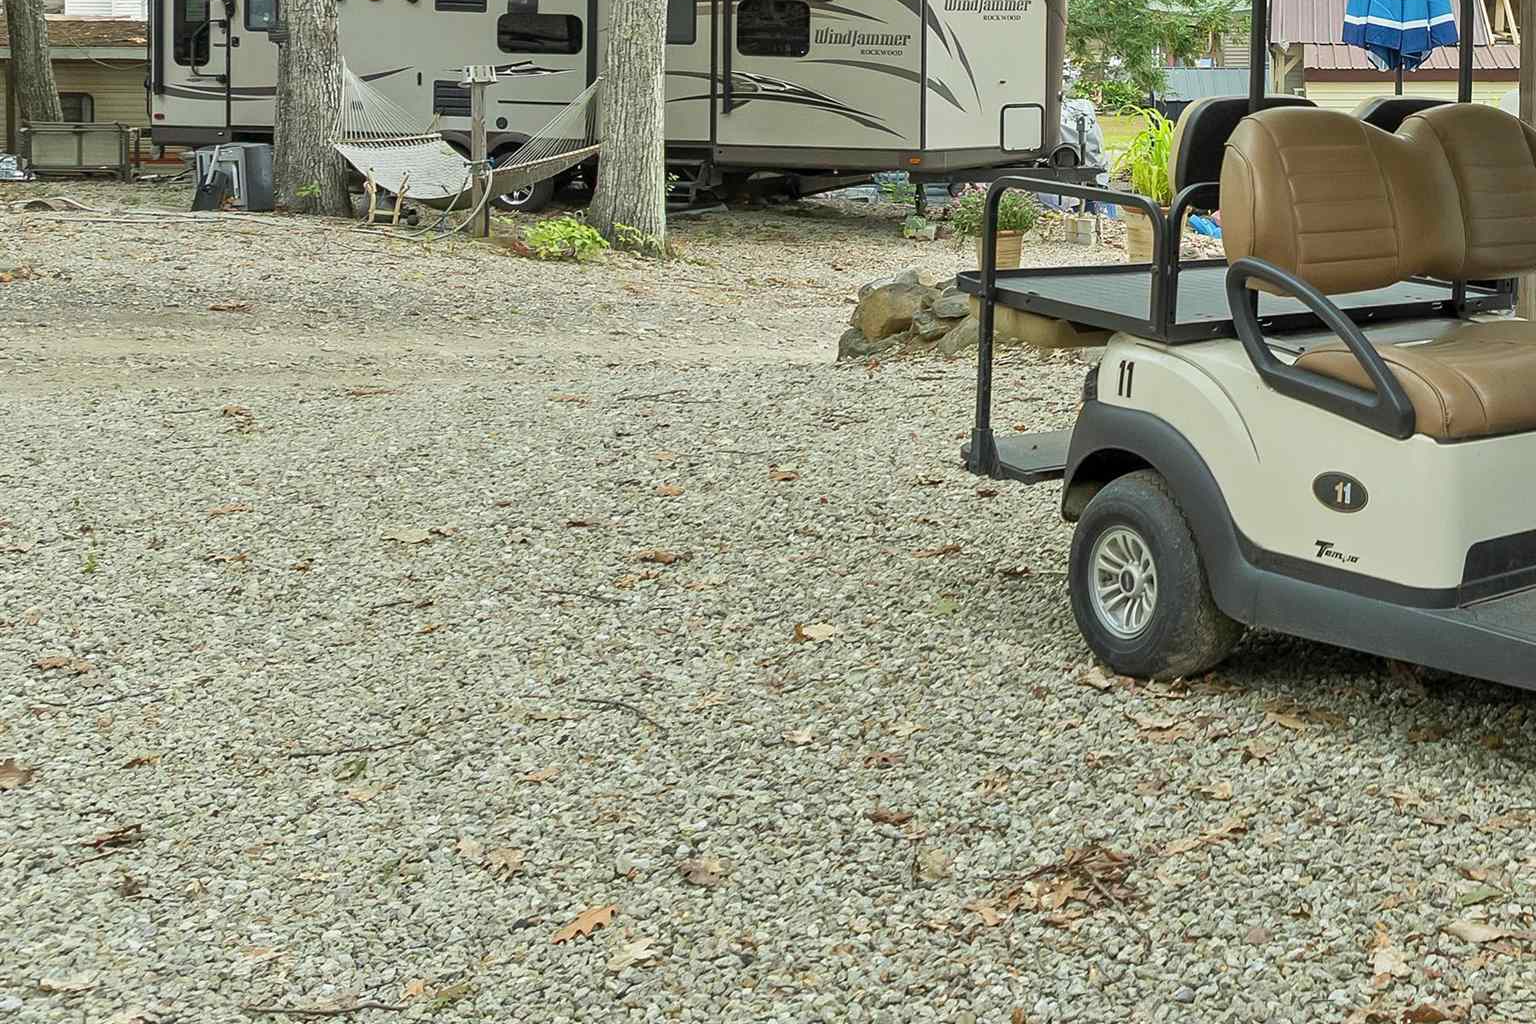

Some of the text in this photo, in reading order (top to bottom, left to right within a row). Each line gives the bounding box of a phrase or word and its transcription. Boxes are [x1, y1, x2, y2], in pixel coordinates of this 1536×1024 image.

[860, 49, 903, 57] ROCKWOOD
[1118, 360, 1134, 398] 11
[1335, 480, 1352, 504] 11
